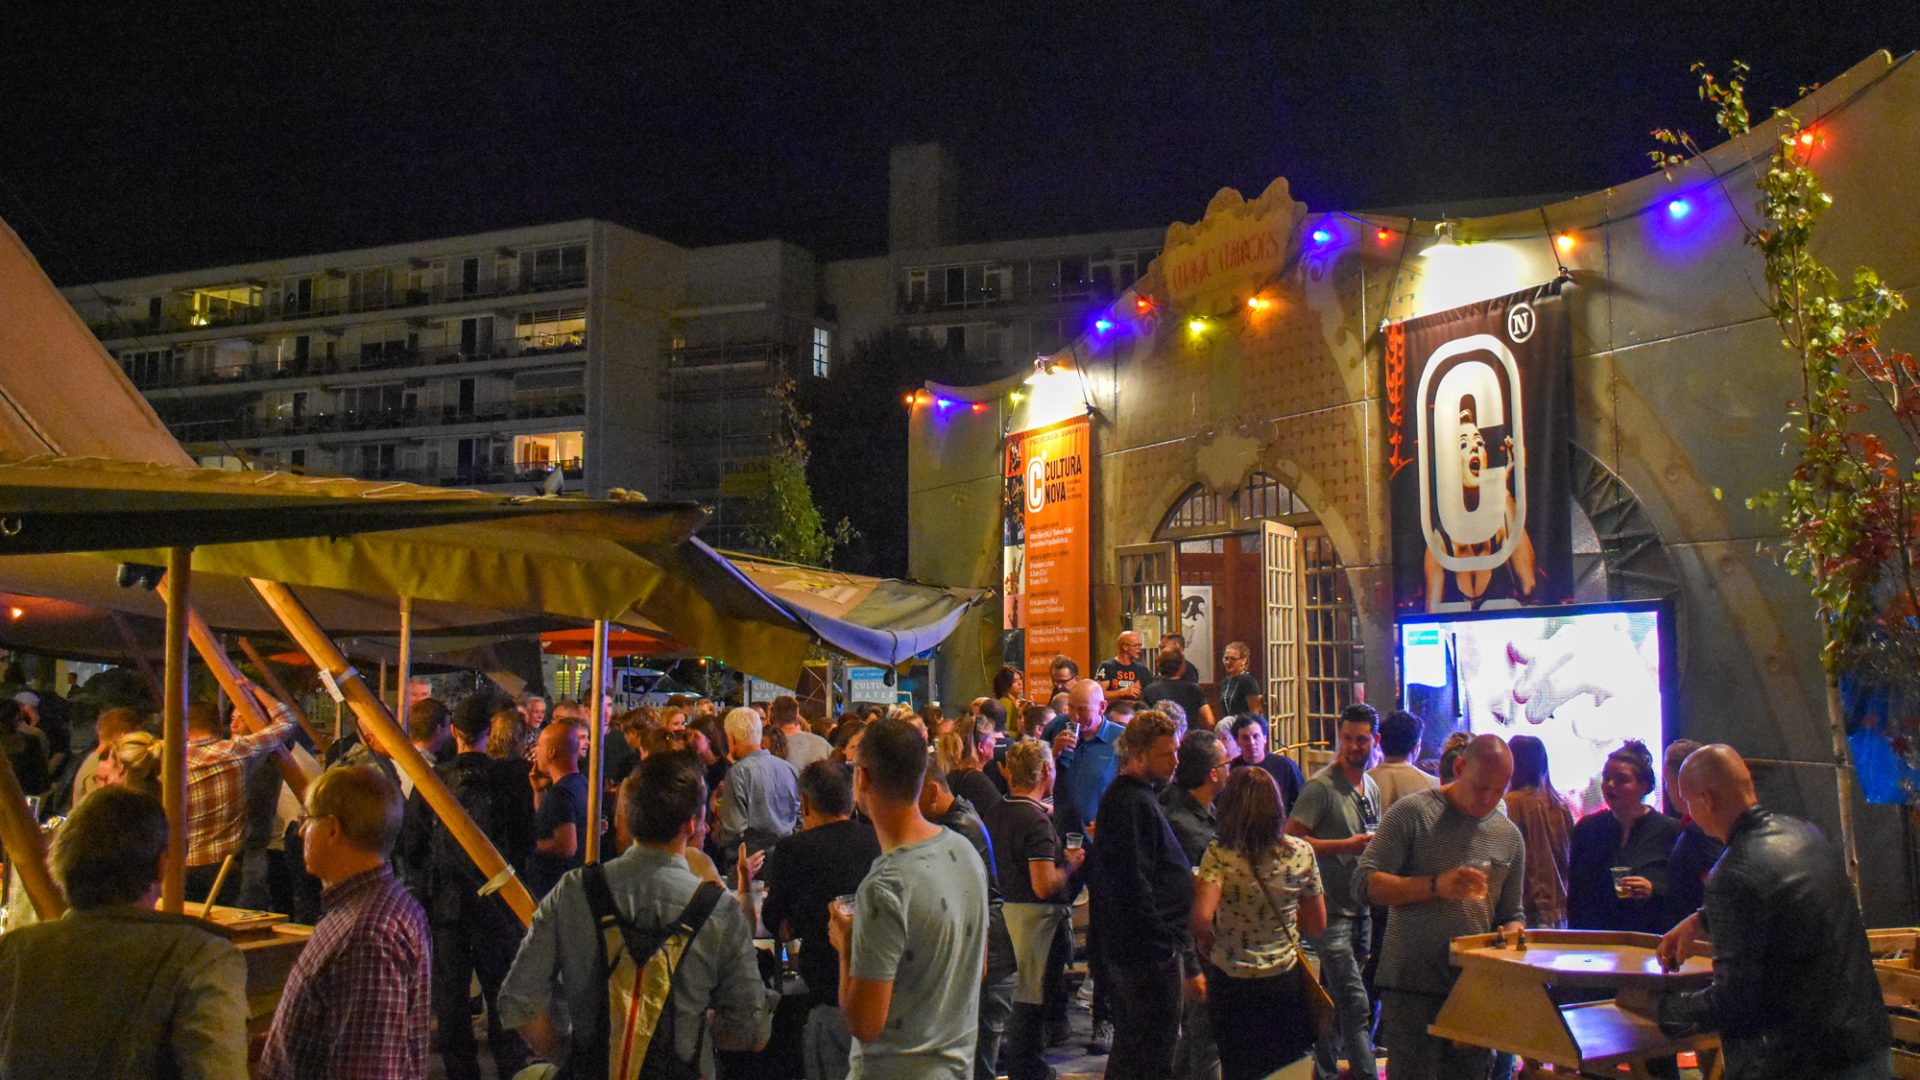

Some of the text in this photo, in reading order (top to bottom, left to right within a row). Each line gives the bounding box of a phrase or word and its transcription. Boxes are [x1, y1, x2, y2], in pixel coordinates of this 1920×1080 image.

[1045, 454, 1082, 481] CULTURA
[1045, 481, 1066, 504] NOVA
[854, 681, 894, 690] CULTU
